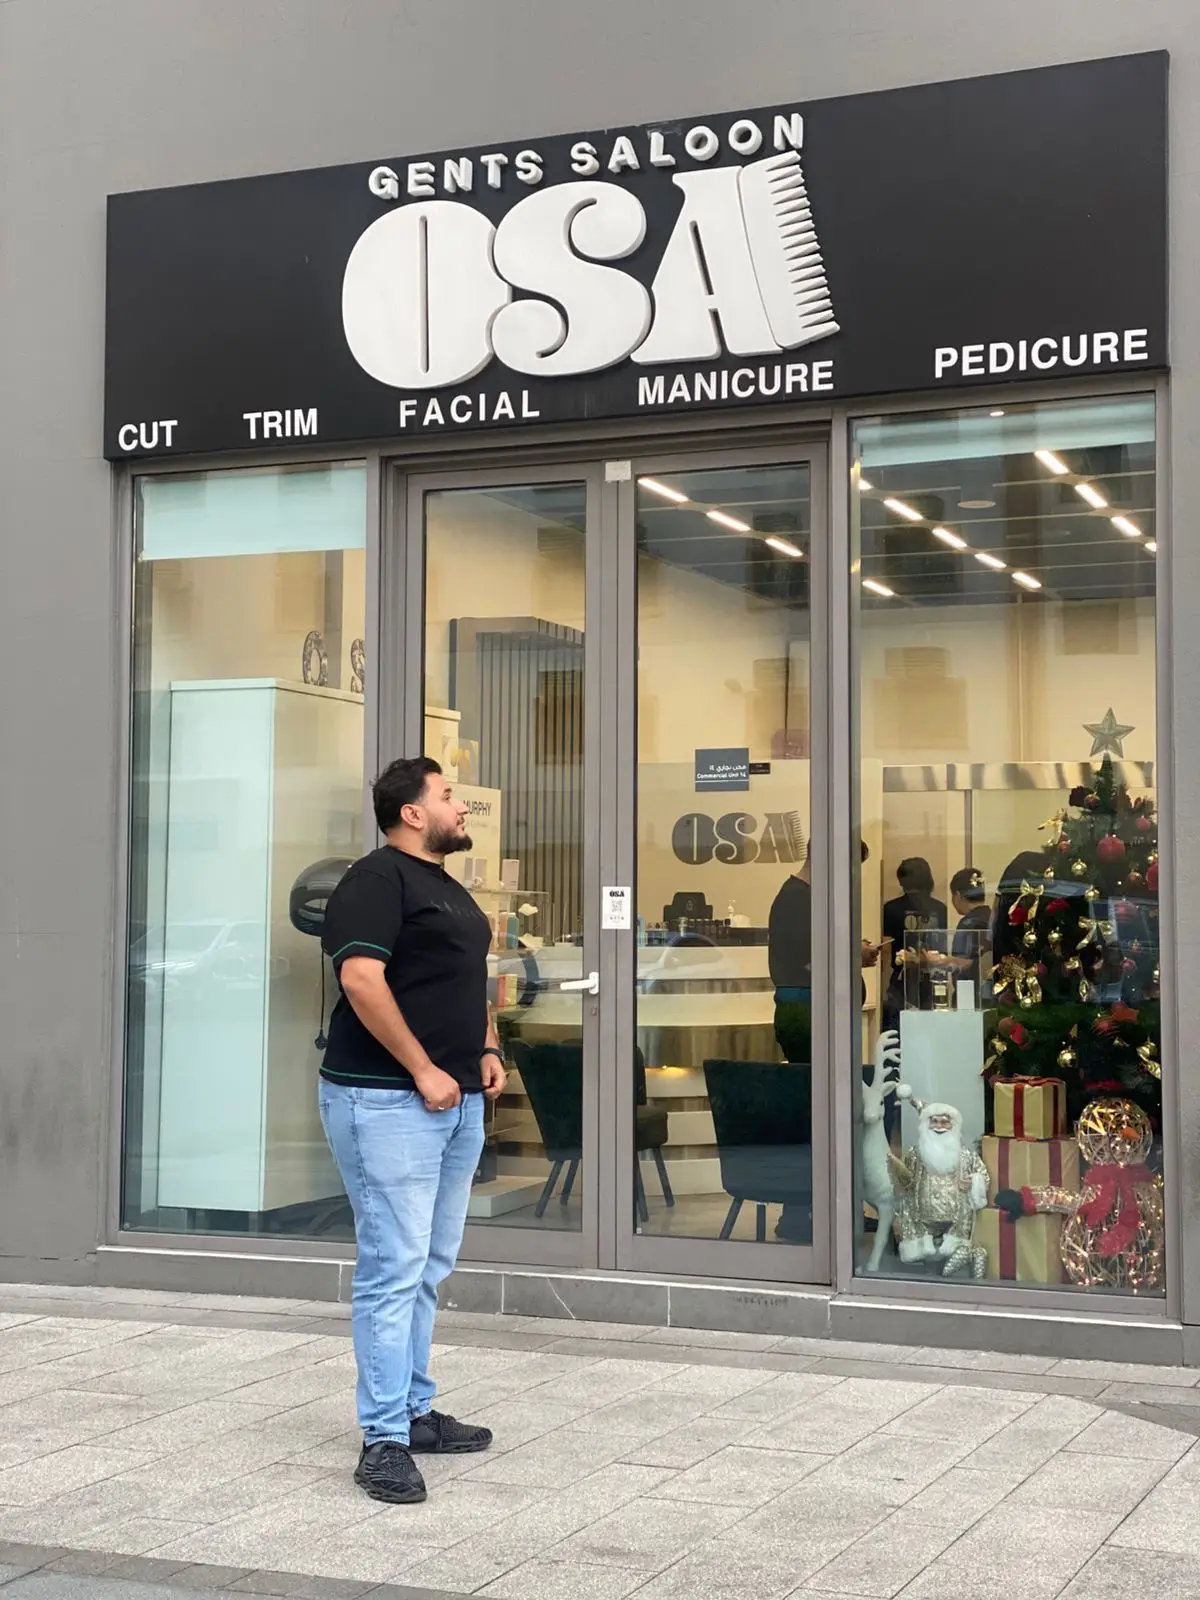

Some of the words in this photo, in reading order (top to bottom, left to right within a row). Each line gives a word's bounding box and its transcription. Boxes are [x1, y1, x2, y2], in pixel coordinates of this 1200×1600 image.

[368, 149, 544, 200] GENTS
[570, 112, 804, 176] SALOON
[341, 150, 840, 390] OSA
[934, 328, 1149, 379] PEDICURE
[637, 360, 834, 406] MANICURE
[242, 407, 318, 440] TRIM
[399, 390, 540, 428] FACIAL
[118, 419, 178, 451] CUT
[671, 811, 807, 865] OSA
